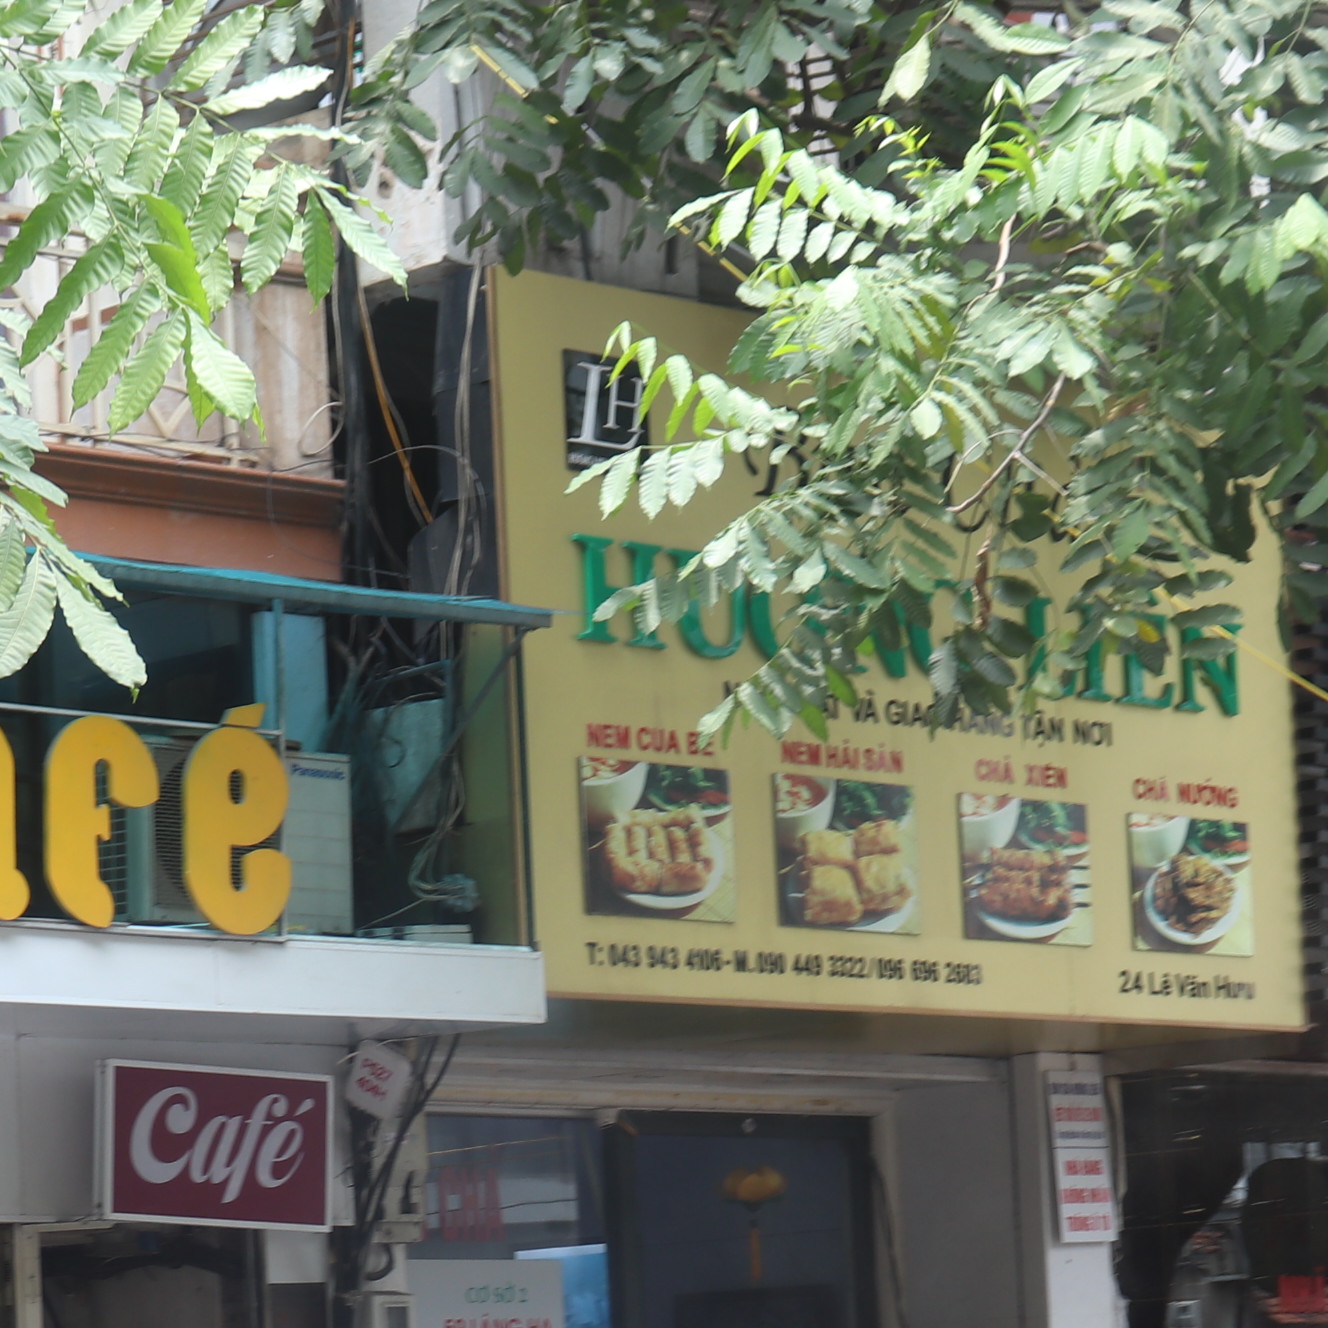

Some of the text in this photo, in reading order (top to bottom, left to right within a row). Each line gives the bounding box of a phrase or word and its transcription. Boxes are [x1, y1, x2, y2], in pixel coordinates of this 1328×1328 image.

[586, 723, 631, 750] NEM
[636, 726, 680, 755] CUA
[781, 739, 822, 767] NEM
[1118, 968, 1144, 995] 24
[129, 1085, 316, 1204] Café
